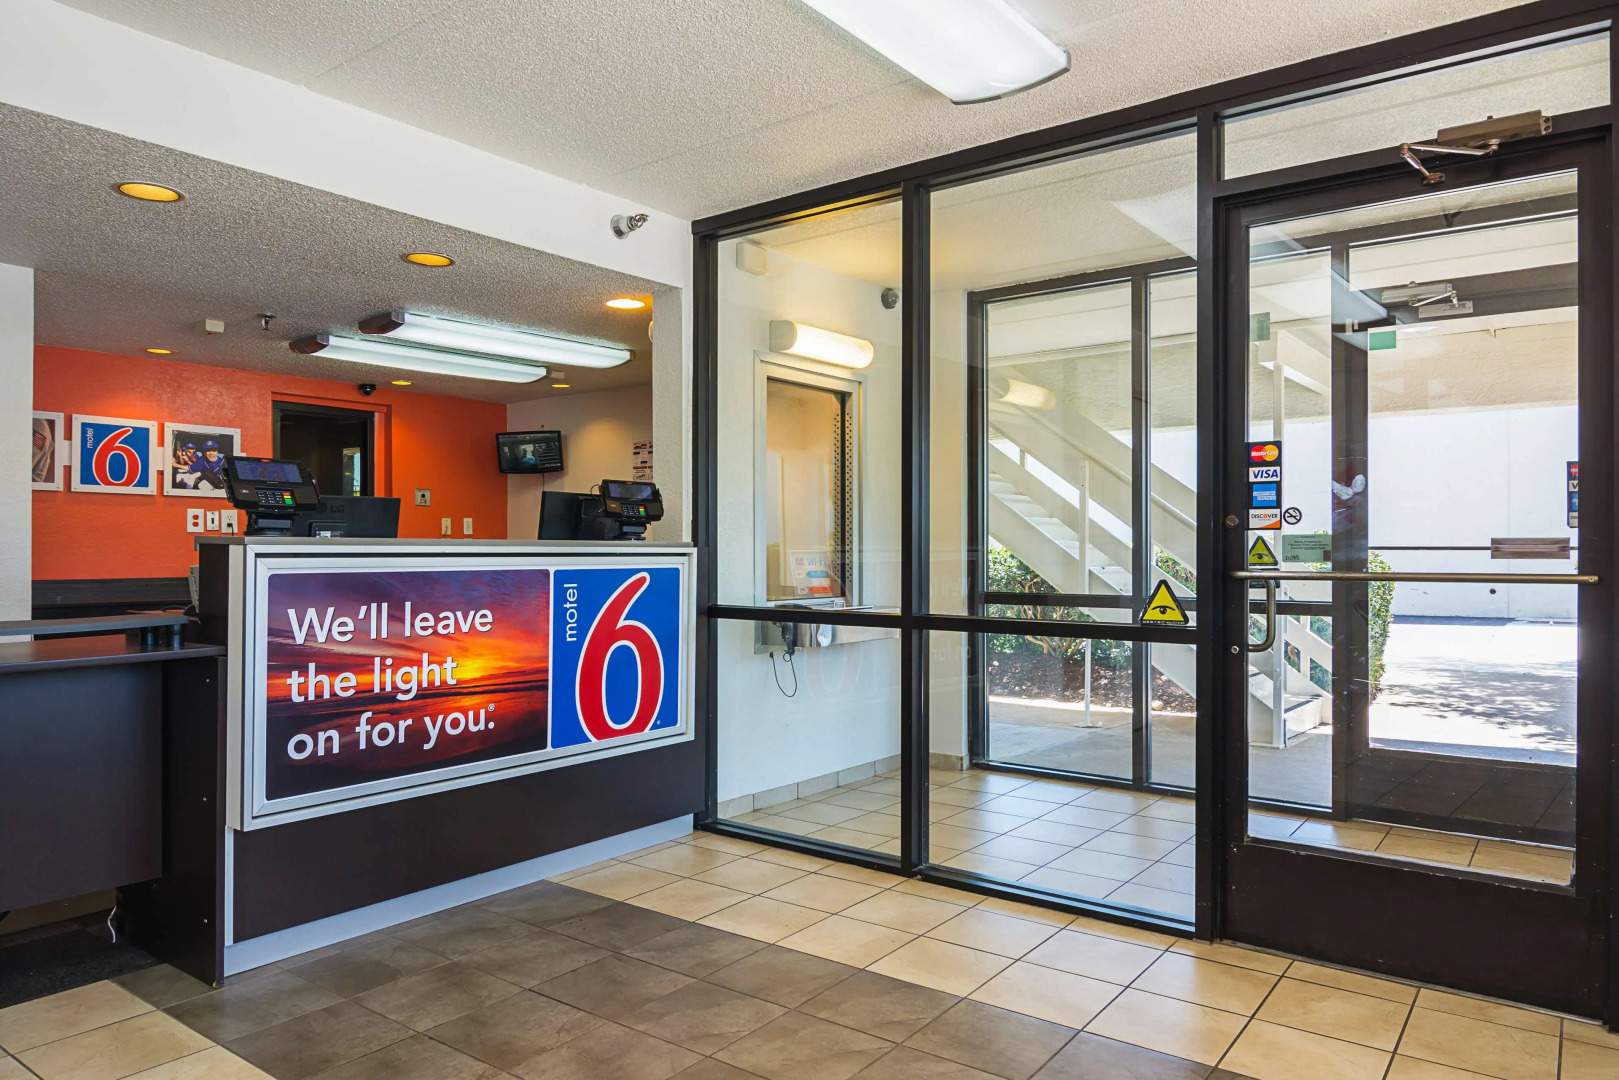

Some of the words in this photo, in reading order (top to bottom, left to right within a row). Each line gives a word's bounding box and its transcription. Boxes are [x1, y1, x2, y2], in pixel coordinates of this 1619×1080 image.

[86, 427, 94, 449] motel
[92, 427, 142, 488] 6
[1253, 469, 1278, 478] VISA
[330, 503, 345, 513] LG
[287, 601, 389, 645] We'll
[404, 600, 494, 638] leave
[286, 662, 357, 703] the
[373, 652, 458, 701] light
[563, 583, 578, 643] motel
[575, 571, 665, 742] 6
[287, 727, 340, 760] on
[356, 711, 413, 750] for
